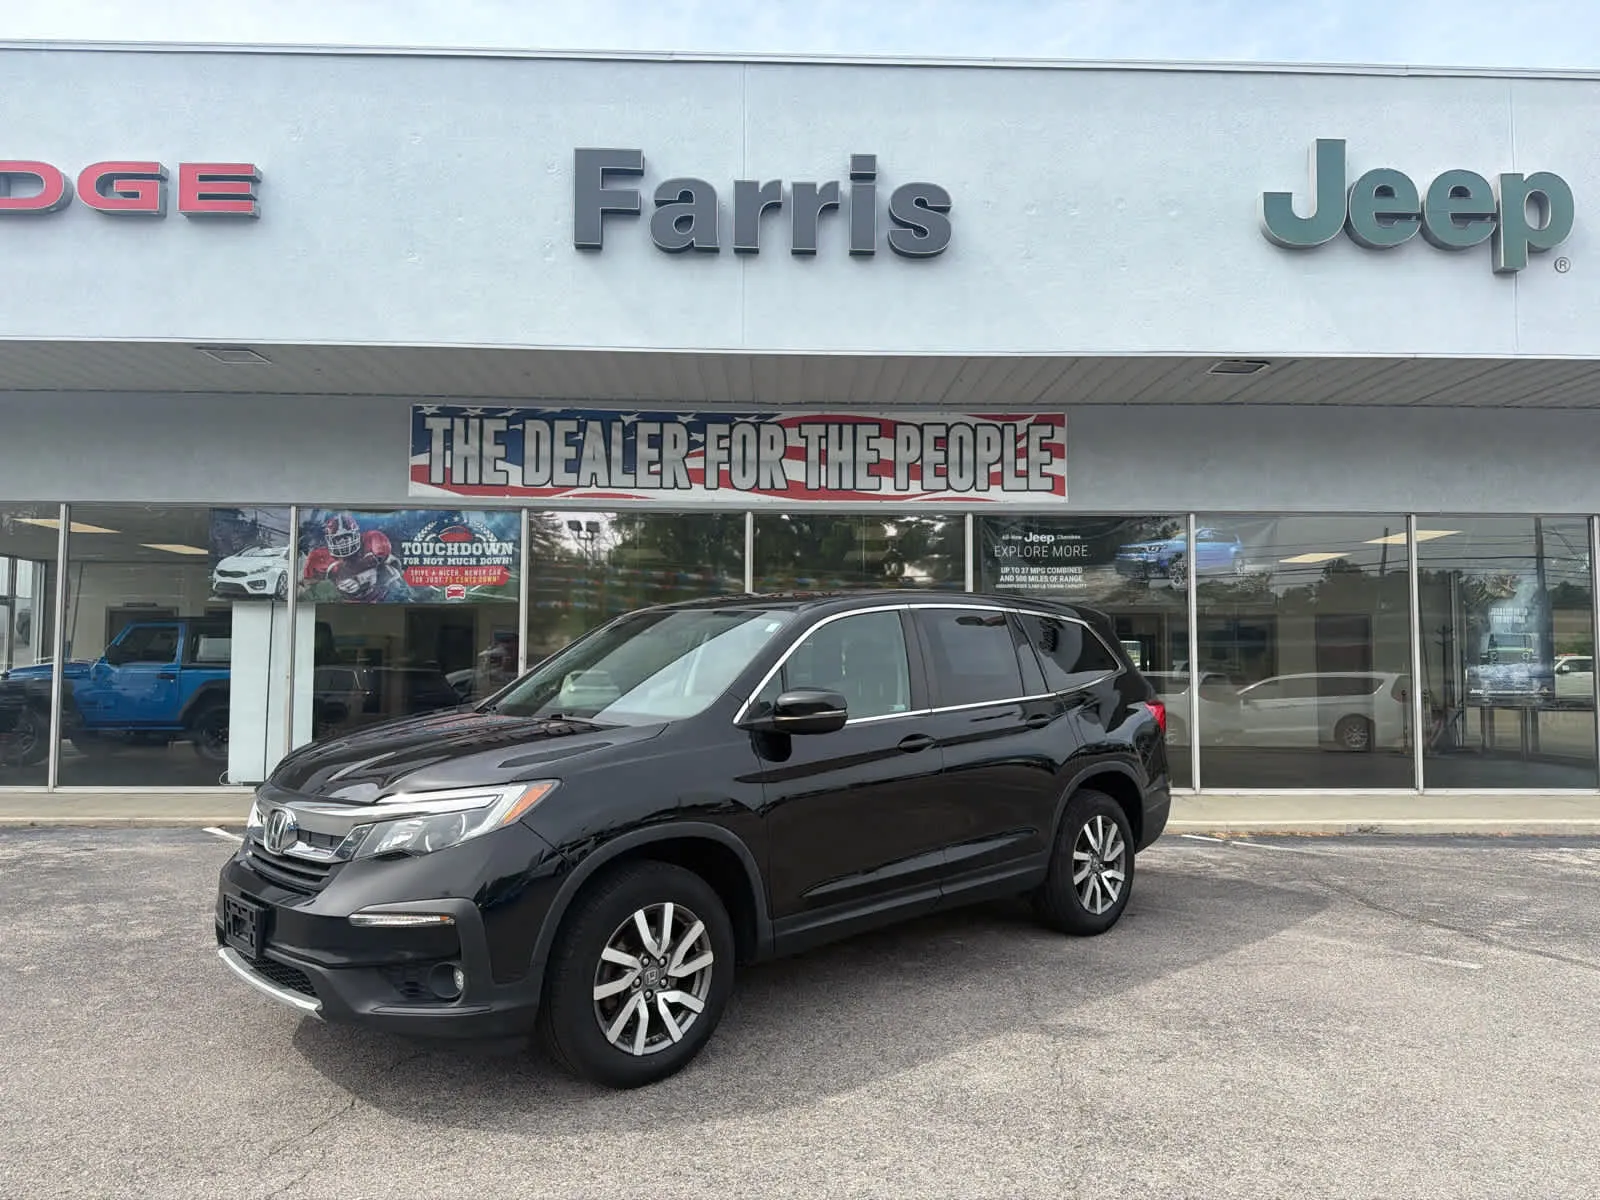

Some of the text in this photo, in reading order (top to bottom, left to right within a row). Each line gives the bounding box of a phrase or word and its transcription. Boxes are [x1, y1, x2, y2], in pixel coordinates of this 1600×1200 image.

[574, 147, 953, 258] Farris
[1261, 138, 1575, 273] Jeep
[424, 416, 1055, 492] THE DEALER FOR THE PEOPLE
[1024, 532, 1055, 544] Jeep
[401, 542, 514, 555] TOUCHDOWN
[994, 544, 1089, 558] EXPLORE MORE
[480, 557, 513, 565] DOWN!
[1046, 566, 1083, 574] COMBINED
